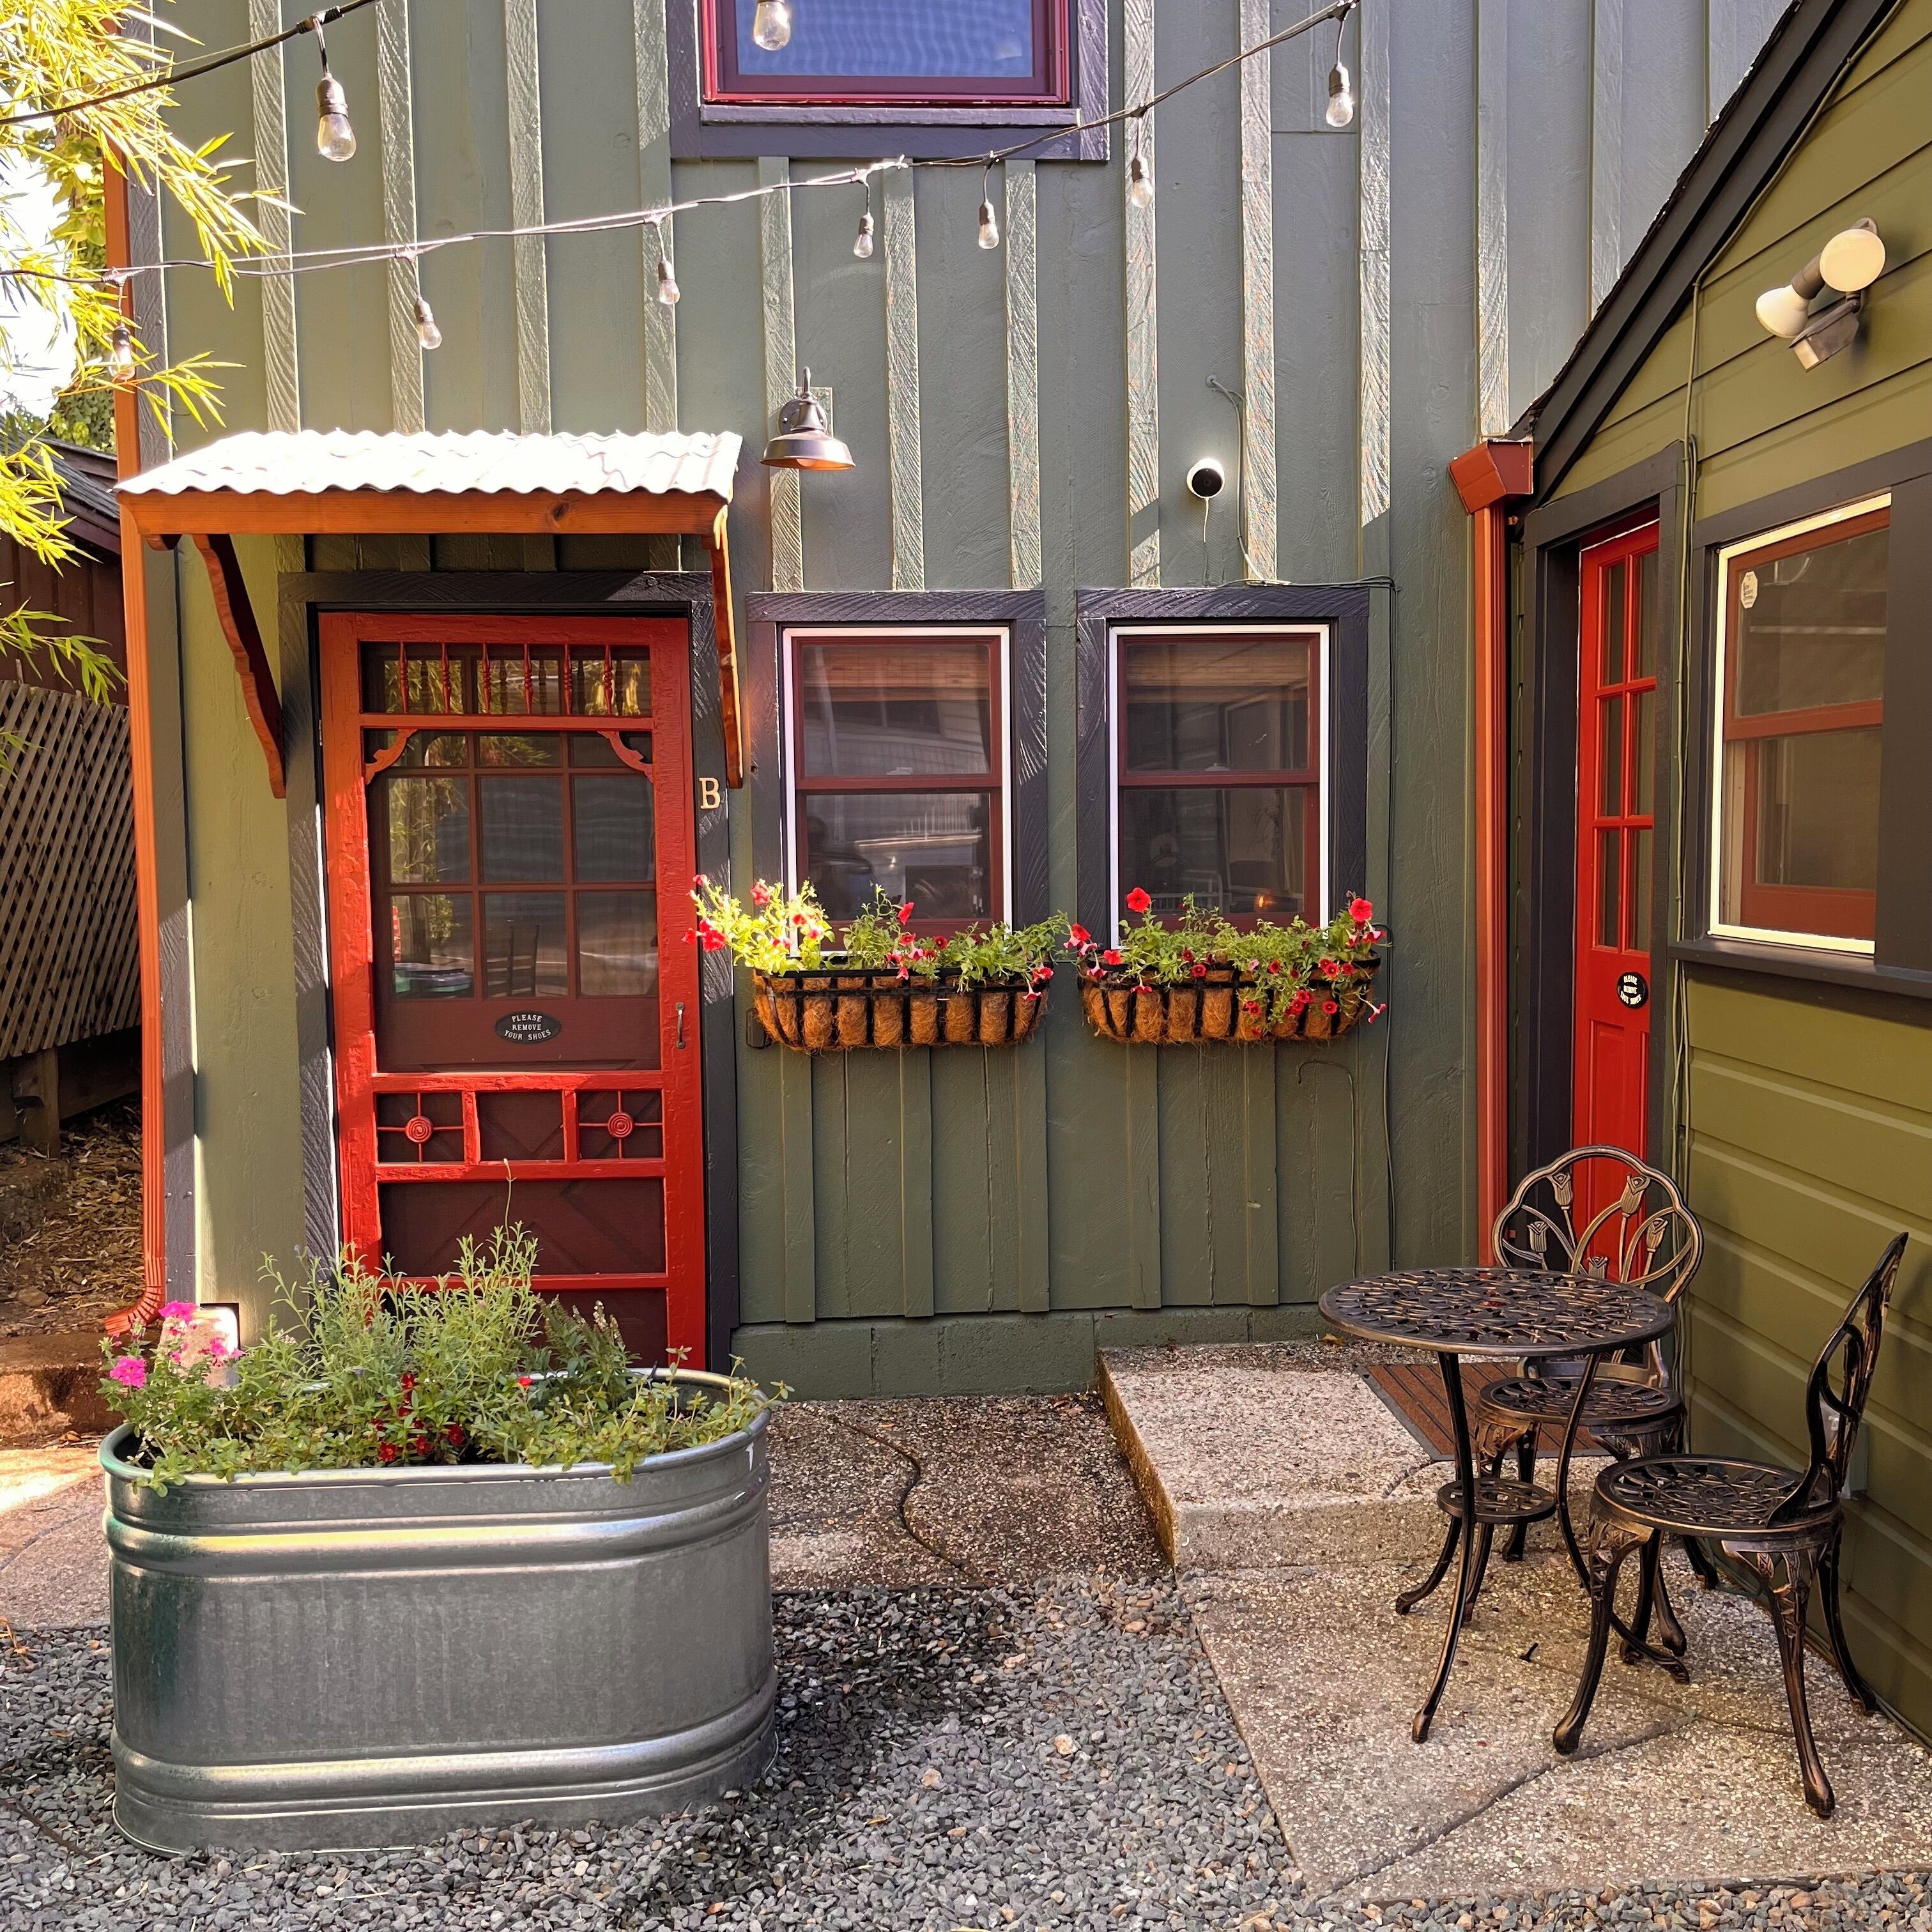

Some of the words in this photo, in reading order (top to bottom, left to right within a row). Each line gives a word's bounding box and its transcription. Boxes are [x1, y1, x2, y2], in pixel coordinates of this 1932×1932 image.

[699, 778, 721, 809] B
[512, 1014, 542, 1022] PLEASE
[504, 1029, 523, 1040] YOUR
[528, 1029, 551, 1041] SHOES
